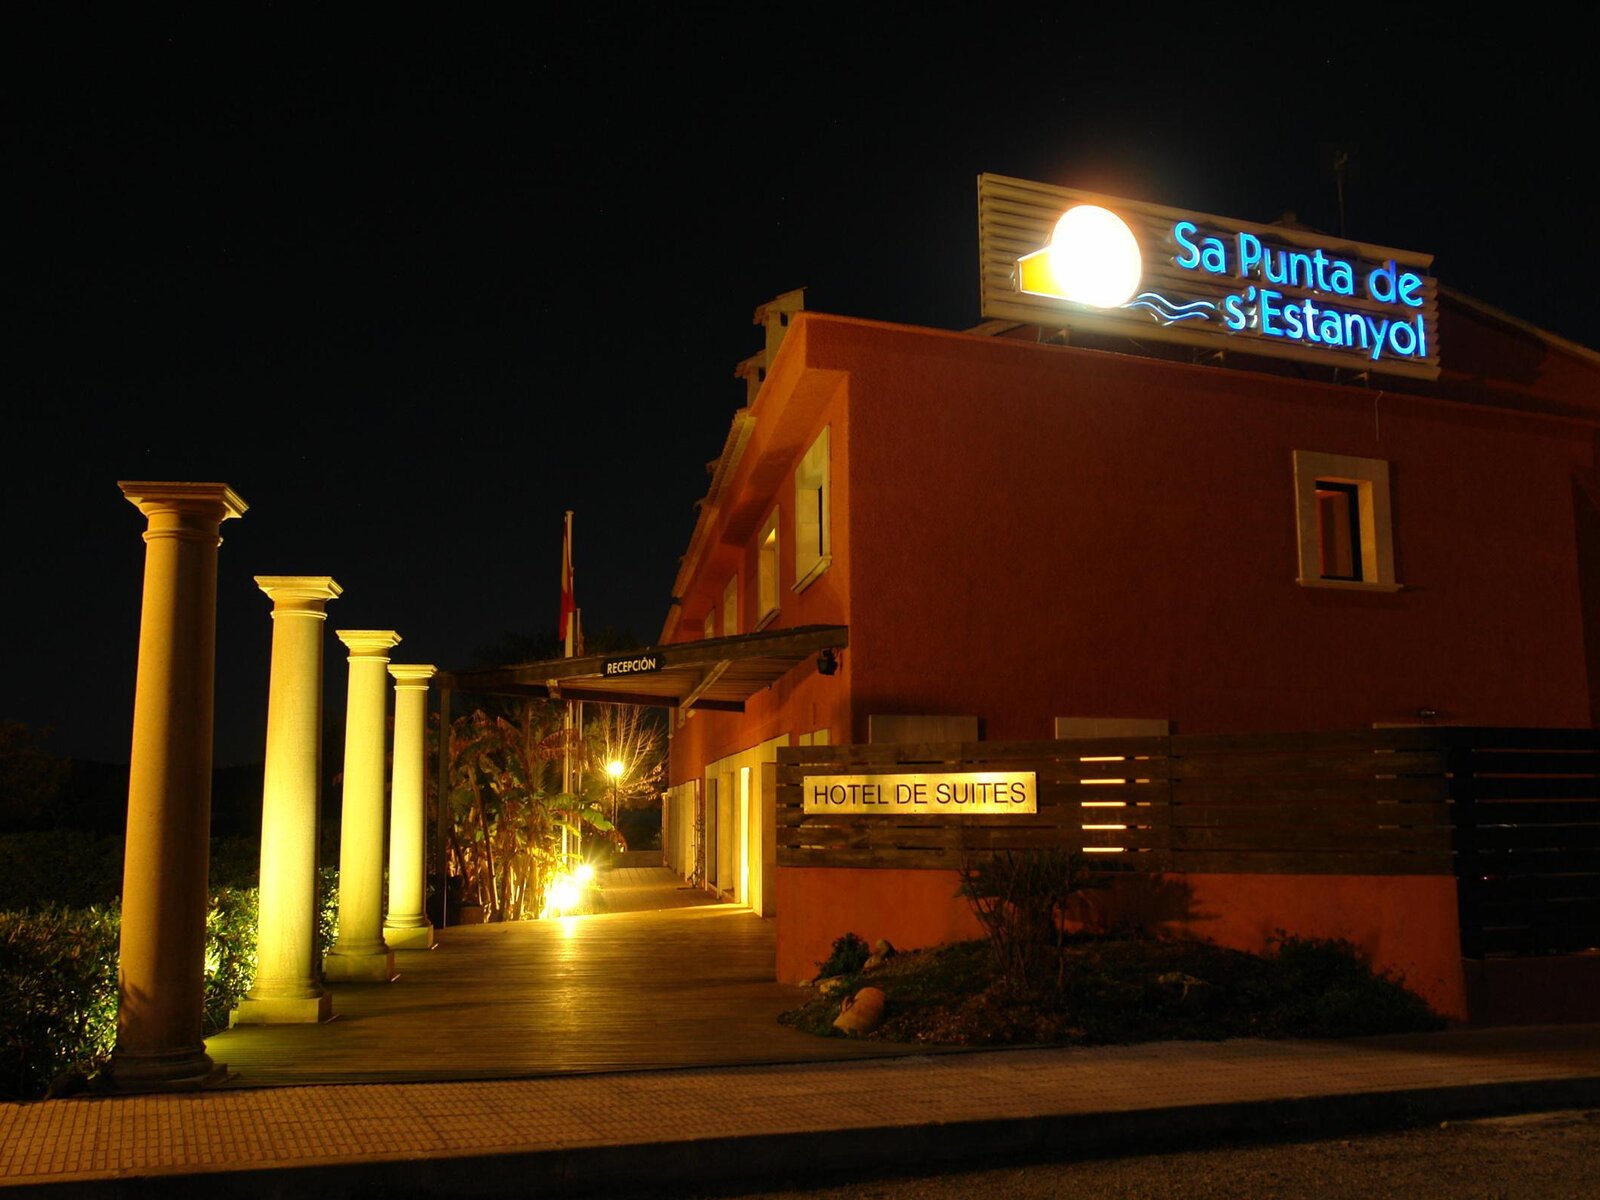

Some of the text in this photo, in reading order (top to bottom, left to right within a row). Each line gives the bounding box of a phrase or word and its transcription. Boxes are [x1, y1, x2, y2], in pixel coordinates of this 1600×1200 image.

[1174, 221, 1424, 307] Sa Punta de
[1224, 285, 1427, 361] s'Estanyol
[606, 656, 656, 675] RECEPCIÓN
[814, 782, 1027, 805] HOTEL DE SUITES
